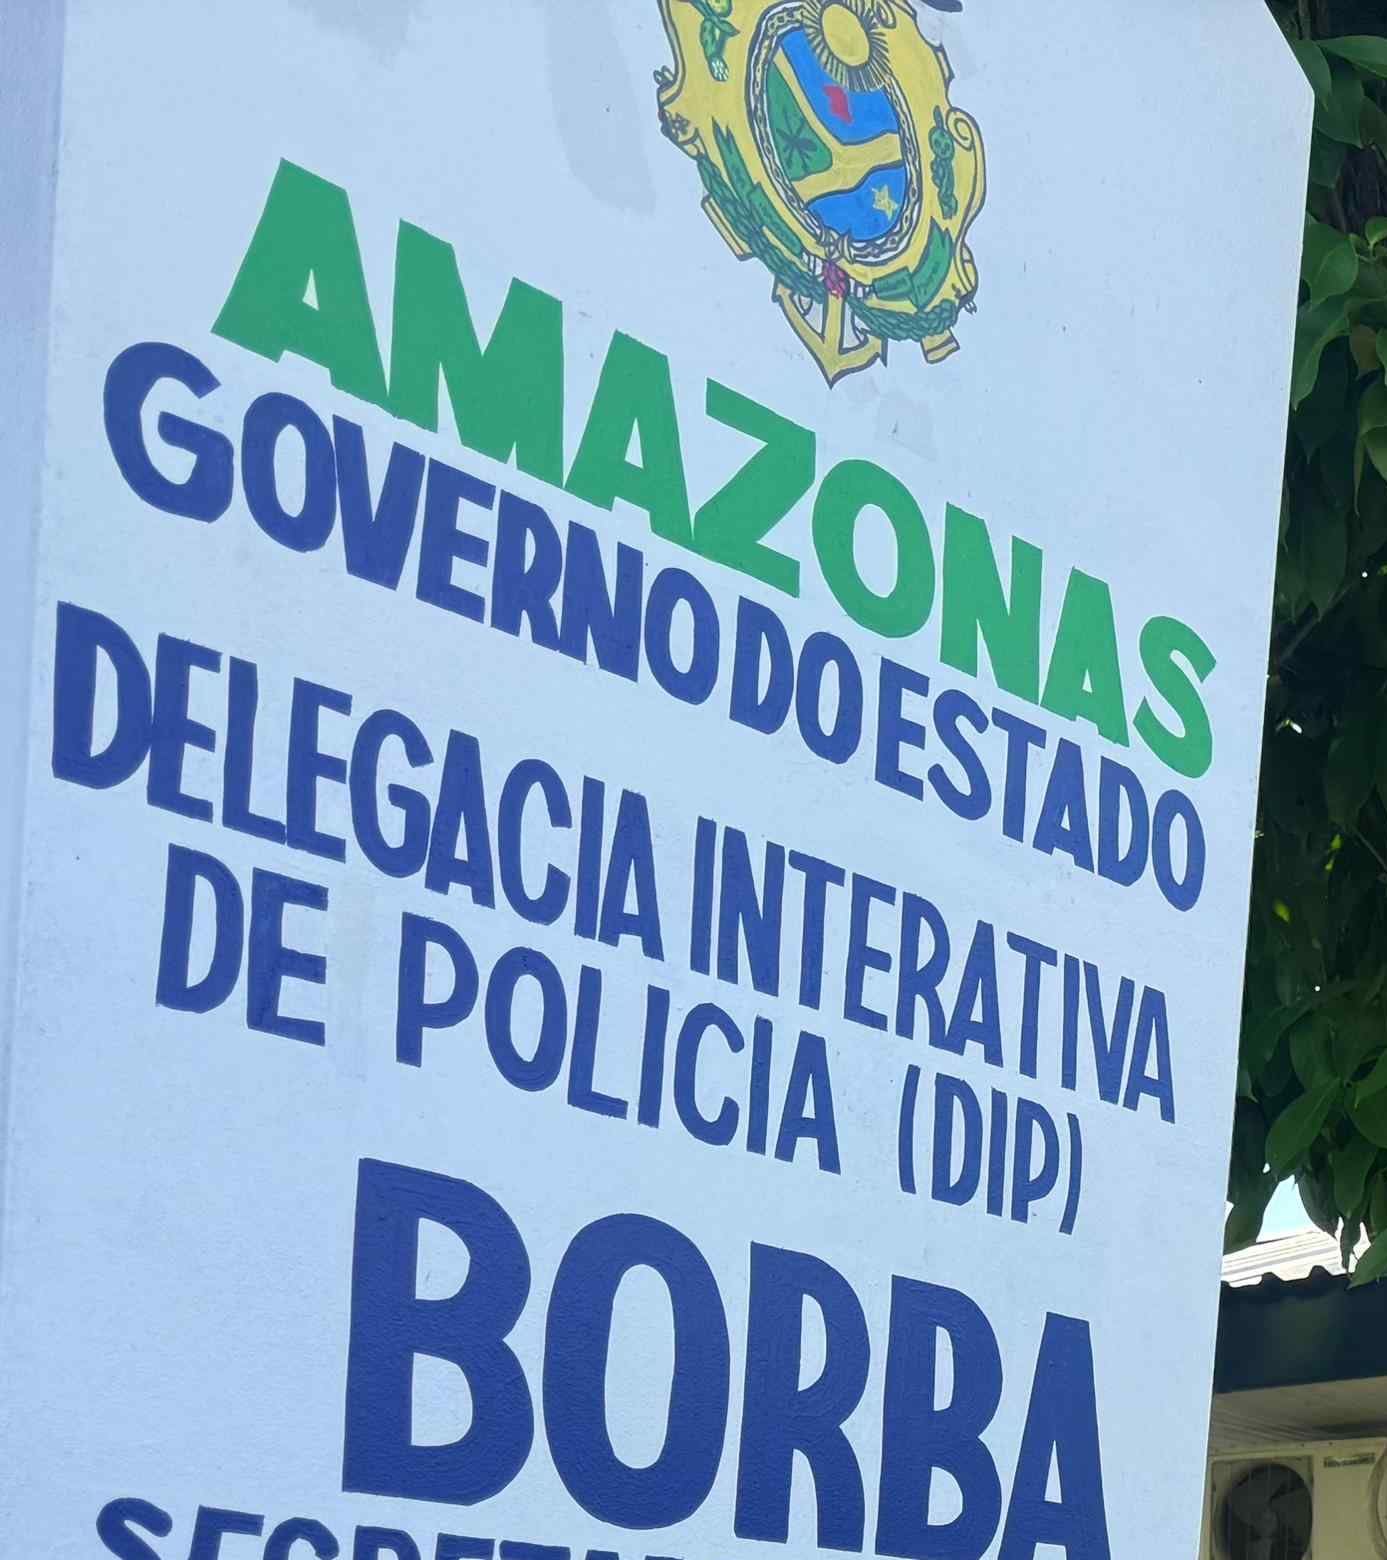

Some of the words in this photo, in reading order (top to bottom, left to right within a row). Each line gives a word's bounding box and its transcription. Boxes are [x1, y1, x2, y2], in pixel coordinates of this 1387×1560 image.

[103, 342, 720, 706] GOVERNO
[729, 595, 864, 765] DO
[874, 656, 1206, 912] ESTADO
[211, 158, 1217, 779] AMAZONAS
[51, 601, 665, 962] DELEGACIA
[690, 815, 1175, 1124] INTERATIVA
[155, 843, 330, 1046] DE
[396, 911, 841, 1175] POLICIA
[898, 1064, 1084, 1235] (DIP)
